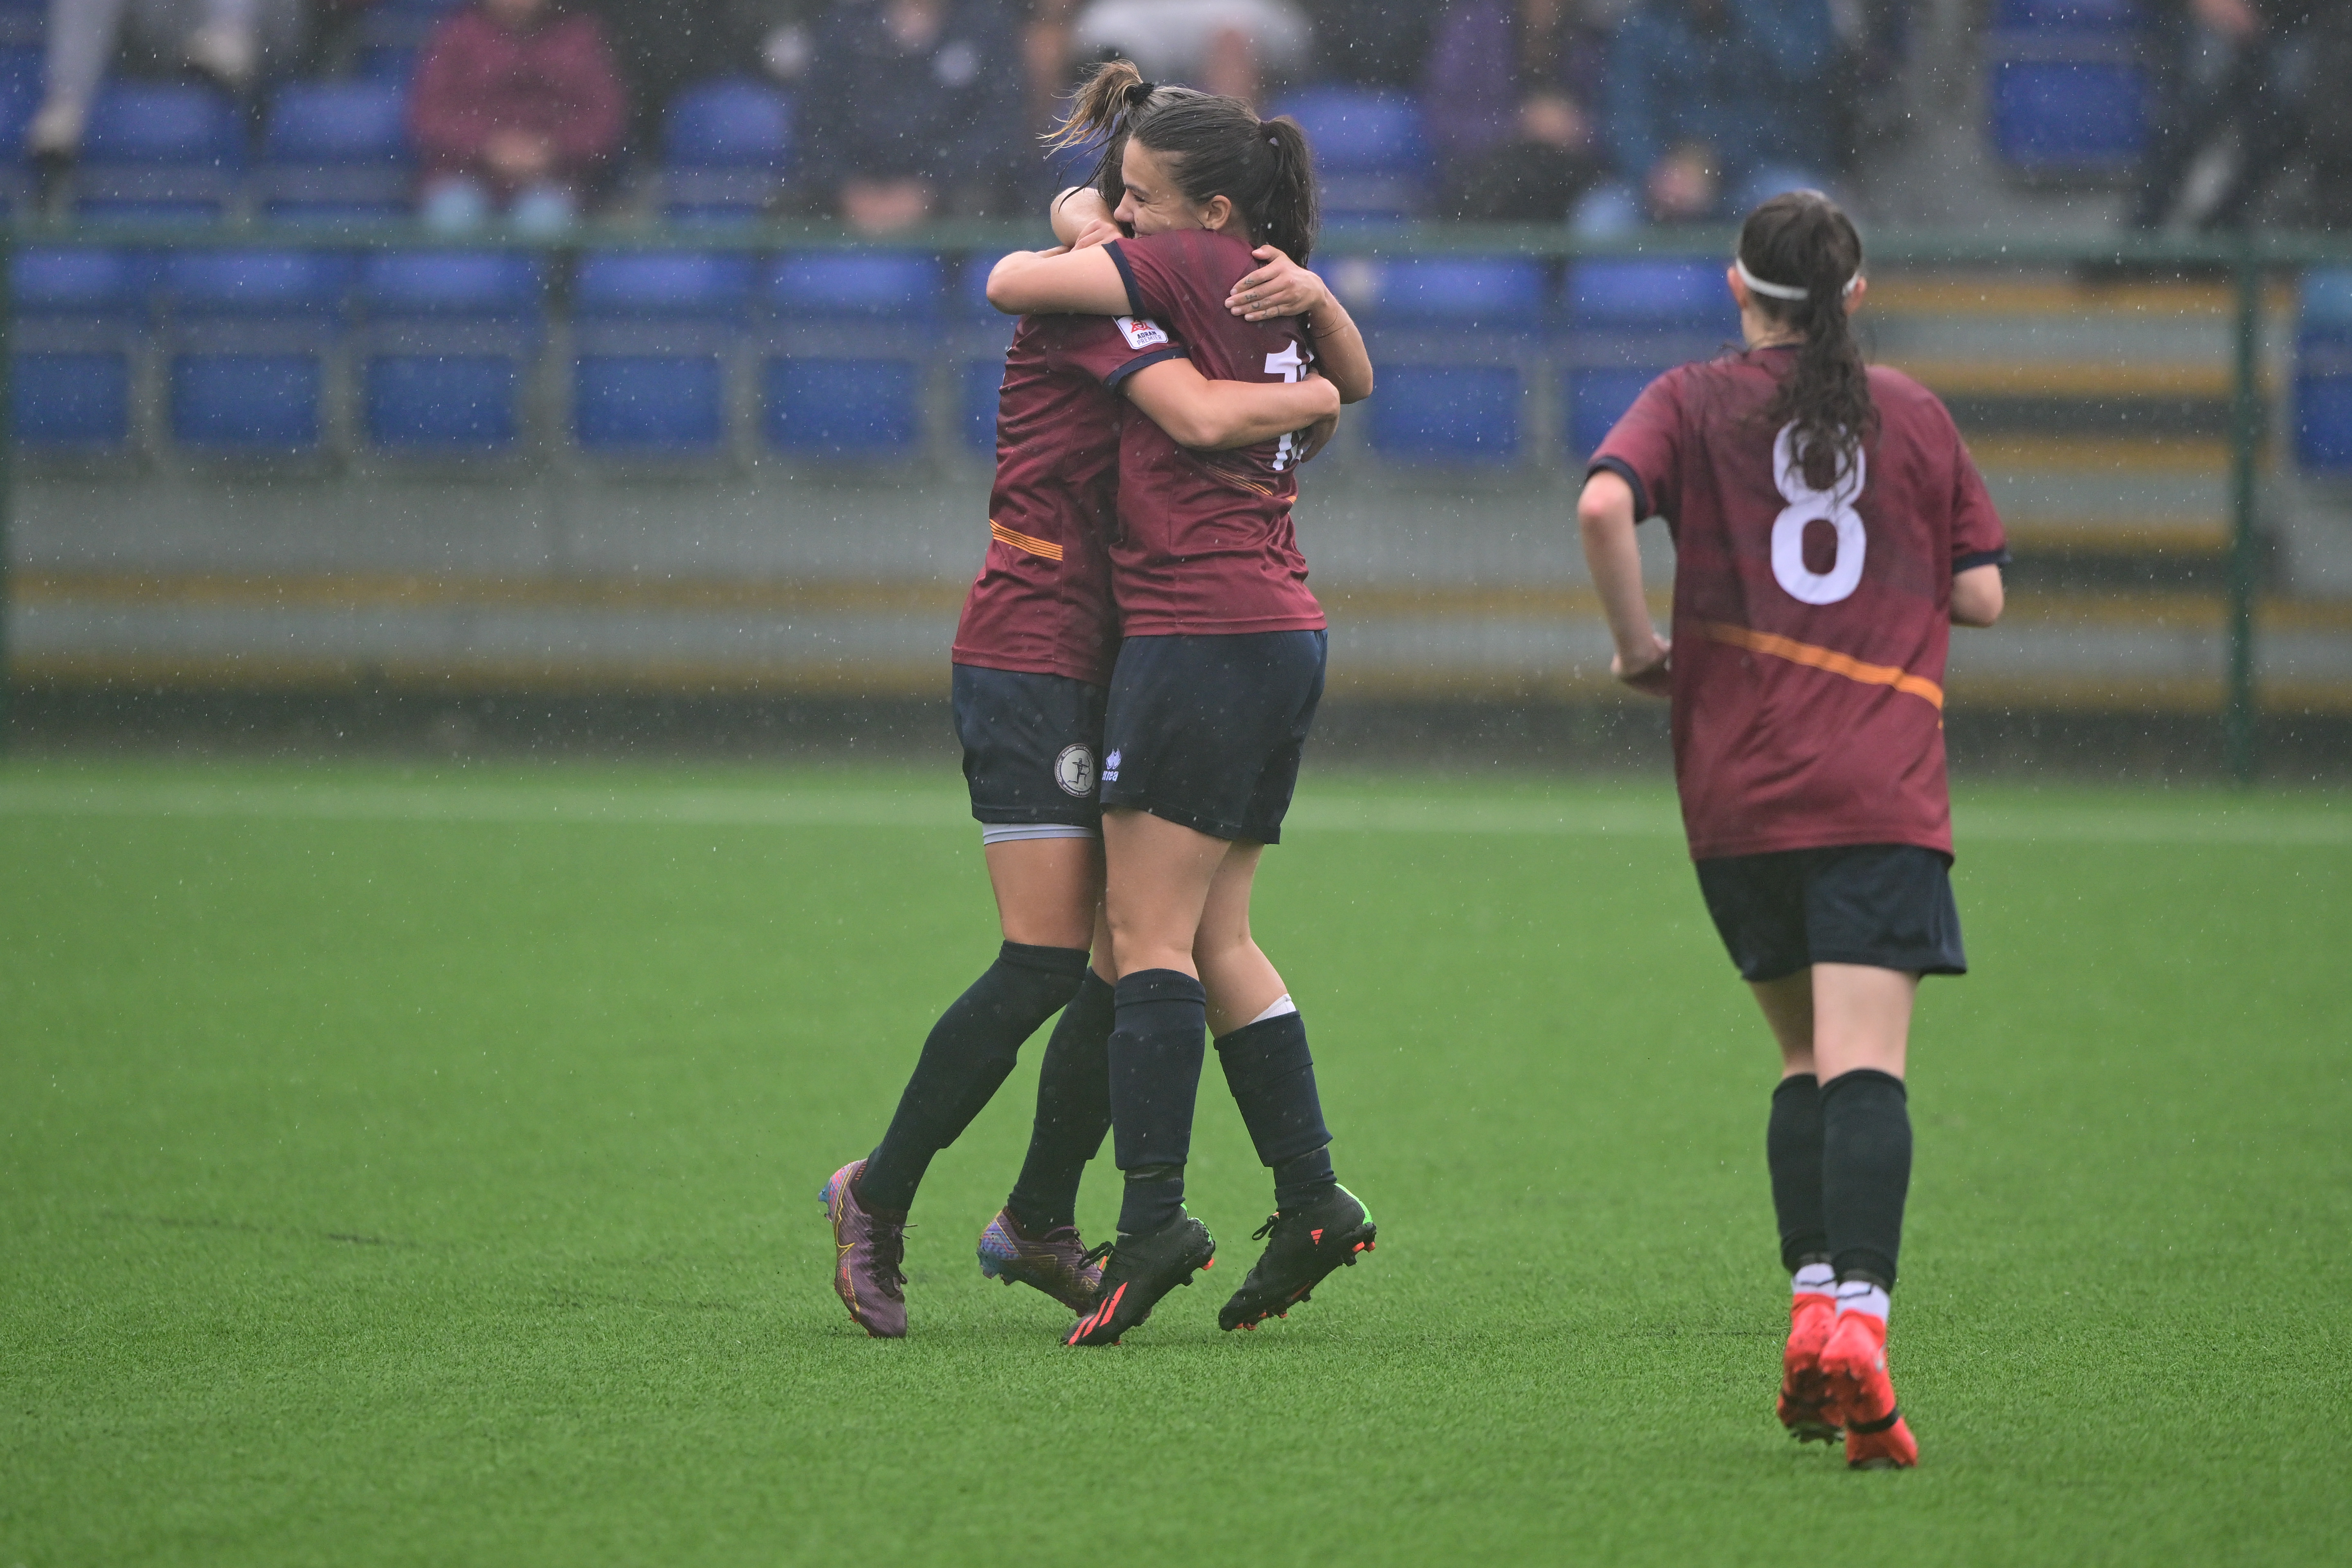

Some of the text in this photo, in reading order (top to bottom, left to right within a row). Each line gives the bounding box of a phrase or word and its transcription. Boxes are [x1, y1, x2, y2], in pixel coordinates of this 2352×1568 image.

[1137, 331, 1157, 340] ADRAN
[1137, 335, 1163, 345] PREMIER
[1771, 418, 1866, 605] 8
[1062, 746, 1076, 757] Cardiff
